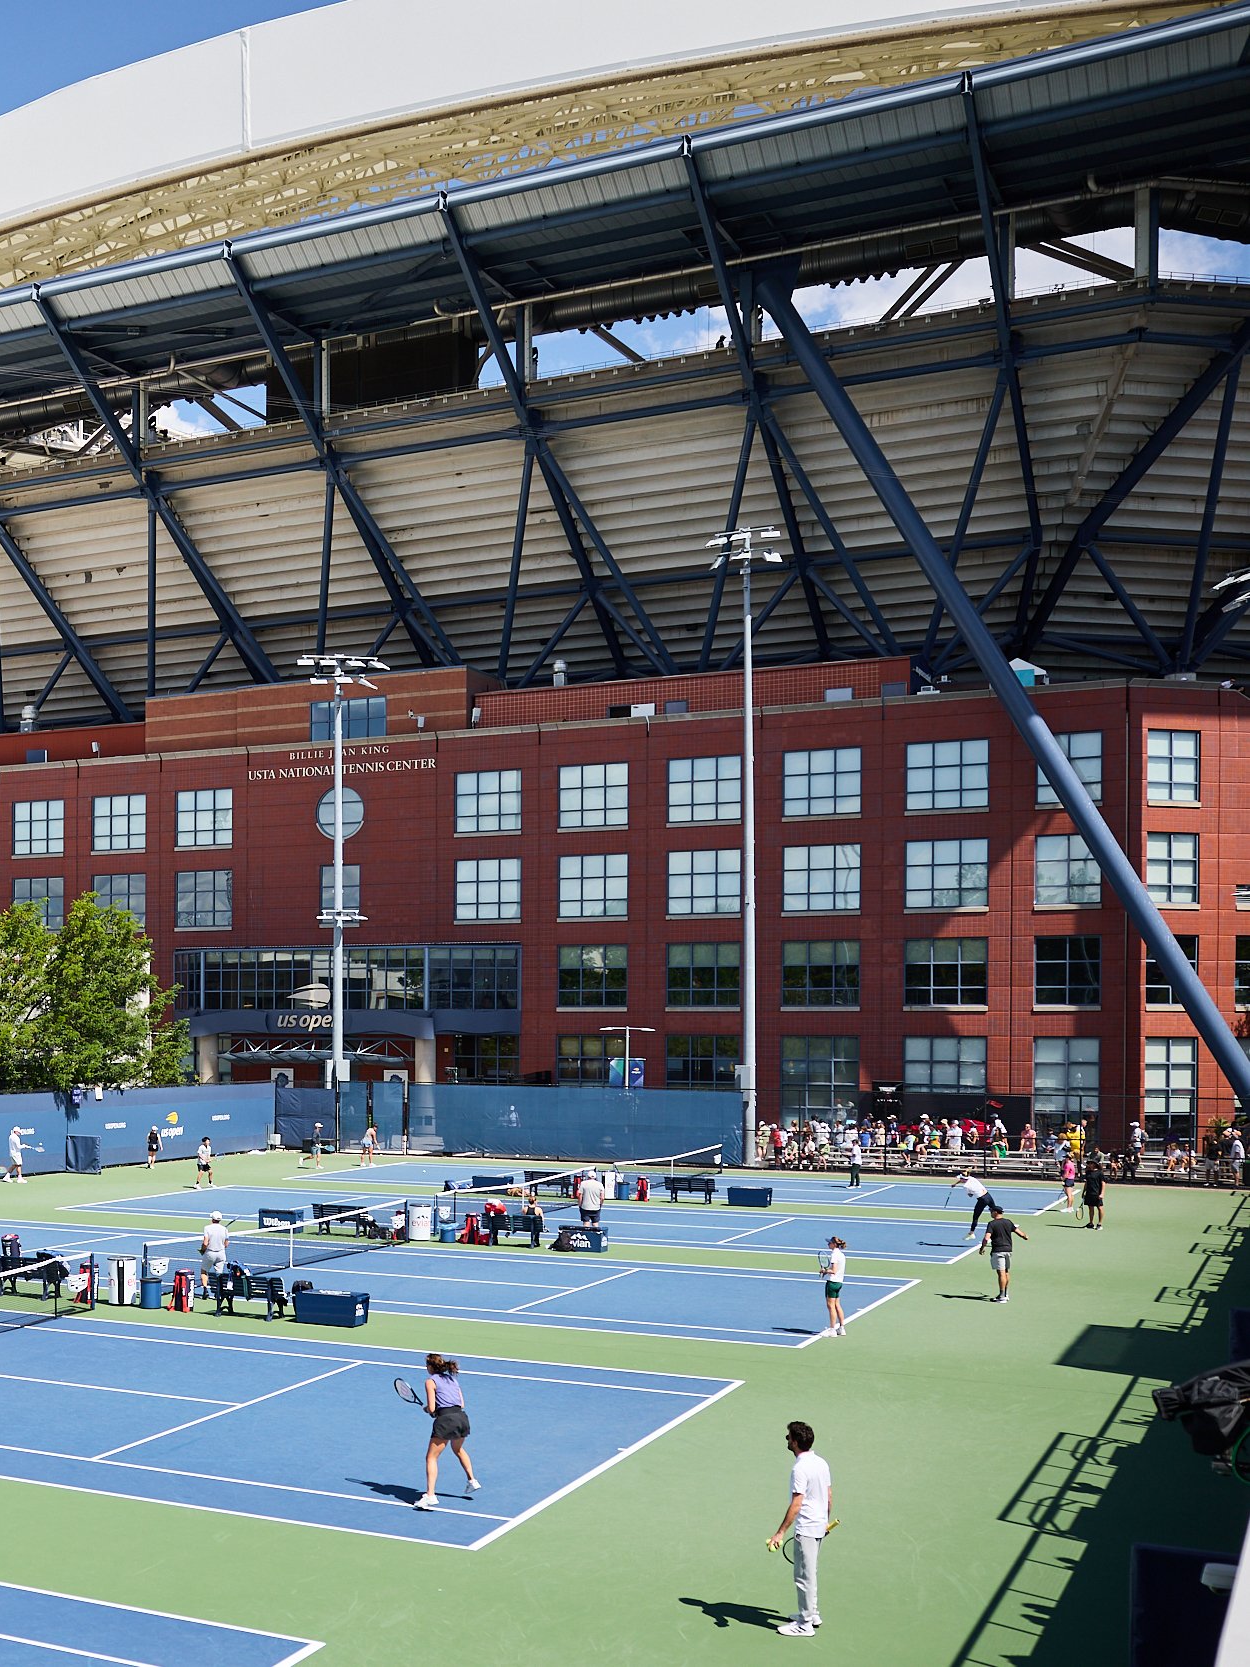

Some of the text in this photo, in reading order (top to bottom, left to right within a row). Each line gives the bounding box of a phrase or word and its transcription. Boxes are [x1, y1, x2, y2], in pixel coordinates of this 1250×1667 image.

[289, 745, 389, 760] BILLIE JAN KING
[248, 770, 276, 781] USTA
[342, 762, 384, 775] TENNIS
[387, 758, 436, 772] CENTER
[277, 1014, 335, 1031] us ope
